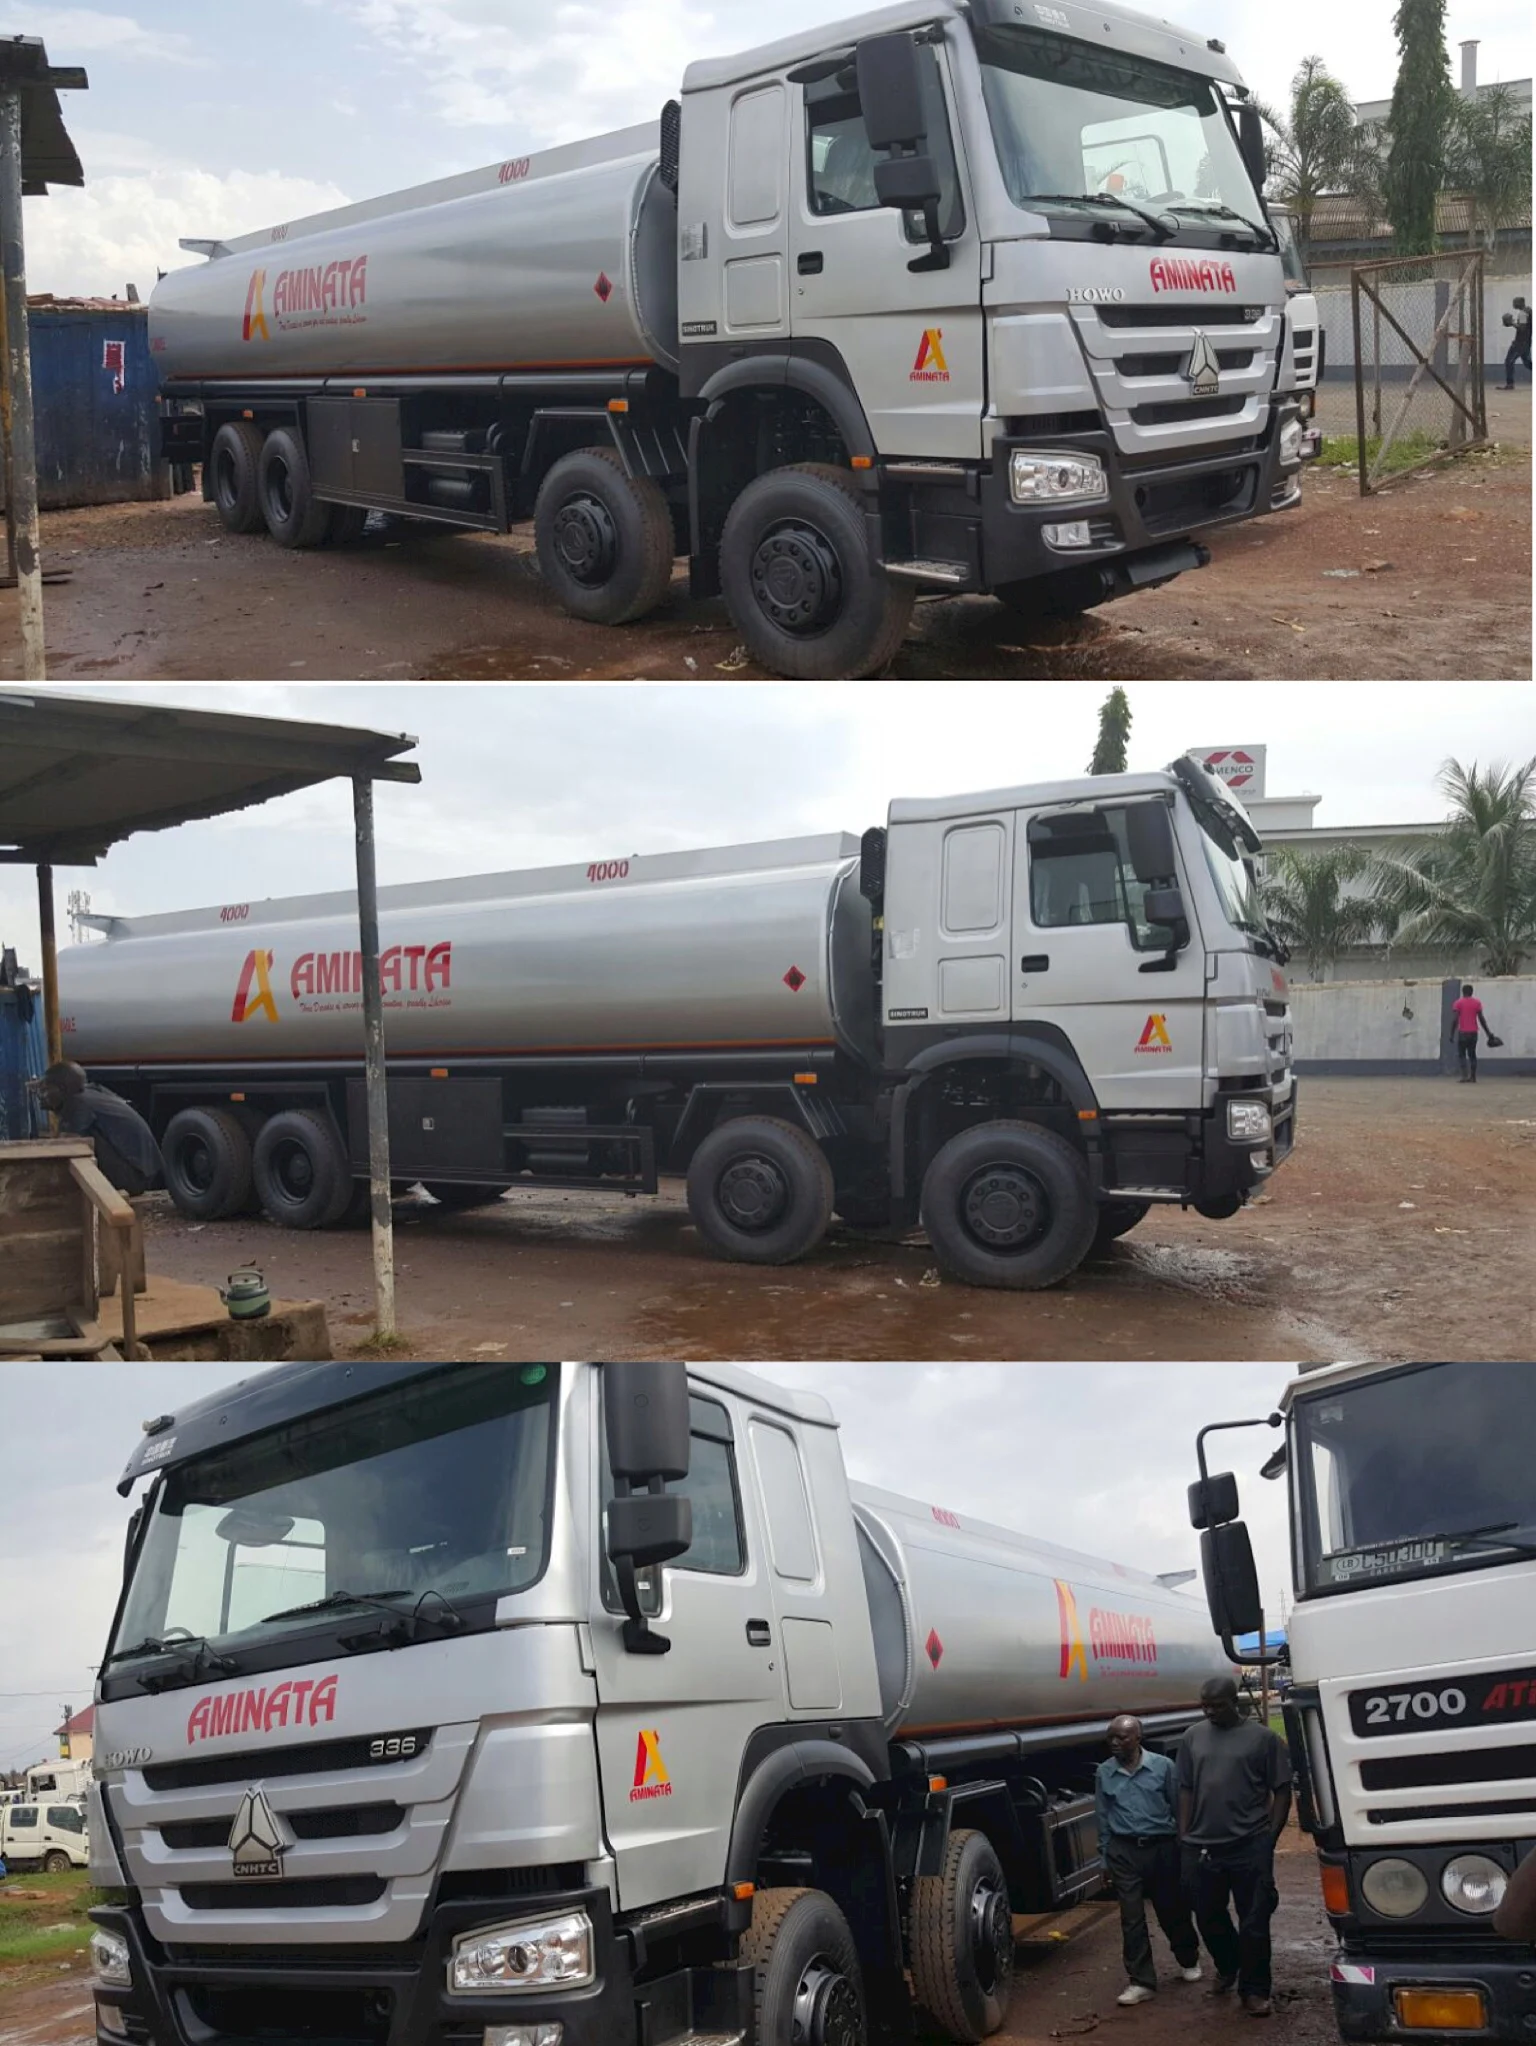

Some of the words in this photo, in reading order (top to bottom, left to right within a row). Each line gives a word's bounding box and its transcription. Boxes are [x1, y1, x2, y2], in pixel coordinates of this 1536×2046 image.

[273, 254, 368, 318] AMINATA
[1150, 257, 1237, 294] AMINATA
[1065, 287, 1126, 301] HOWO
[909, 371, 950, 382] AMINATA
[586, 860, 630, 883] 4000
[1133, 1045, 1173, 1054] AMINATA
[1088, 1607, 1157, 1663] AMINATA
[187, 1674, 338, 1745] AMINATA
[1365, 1688, 1467, 1724] 2700
[369, 1736, 416, 1758] 336
[629, 1782, 672, 1803] AMINATA
[234, 1863, 277, 1874] CNHTC
